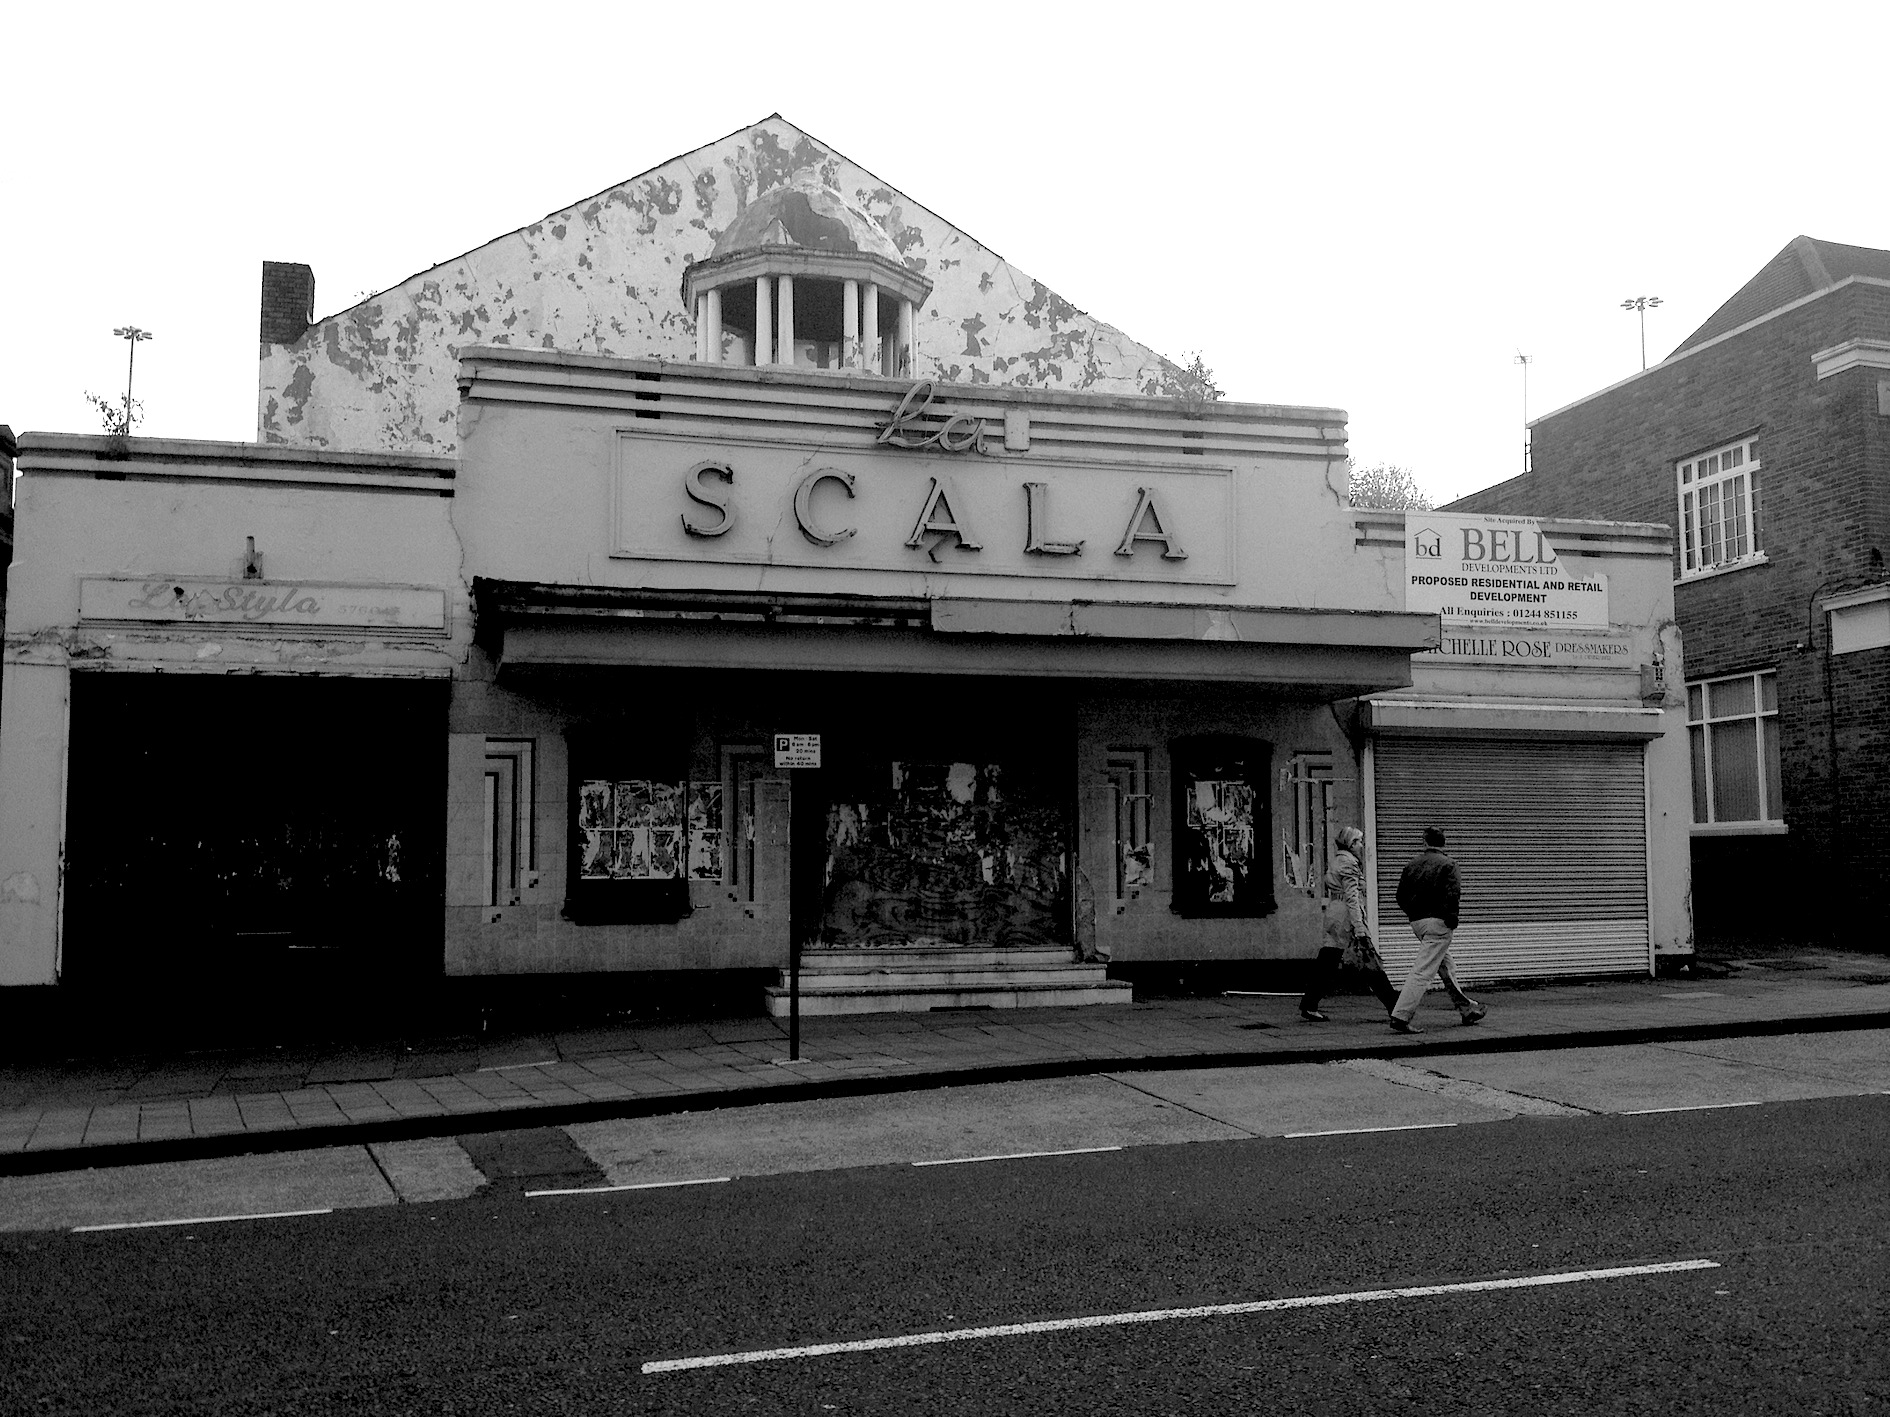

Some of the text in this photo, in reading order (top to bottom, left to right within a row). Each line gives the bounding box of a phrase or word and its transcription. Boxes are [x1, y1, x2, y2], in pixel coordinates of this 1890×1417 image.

[874, 379, 989, 456] La
[681, 459, 1189, 561] SCALA
[1414, 536, 1442, 557] bd
[1460, 528, 1557, 564] BELL
[1462, 563, 1558, 576] DEVELOPMENTS LTD
[1412, 576, 1603, 592] PROPOSED RESIDENTIAL AND RETAIL
[1470, 592, 1547, 603] DEVELOPMENT
[1440, 606, 1454, 616] All
[1457, 607, 1504, 618] Enquiries
[1513, 610, 1541, 618] 01244
[1544, 611, 1578, 620] 851155
[1421, 638, 1629, 658] CHELLE ROSE DRESSMAKERS
[780, 738, 788, 750] P
